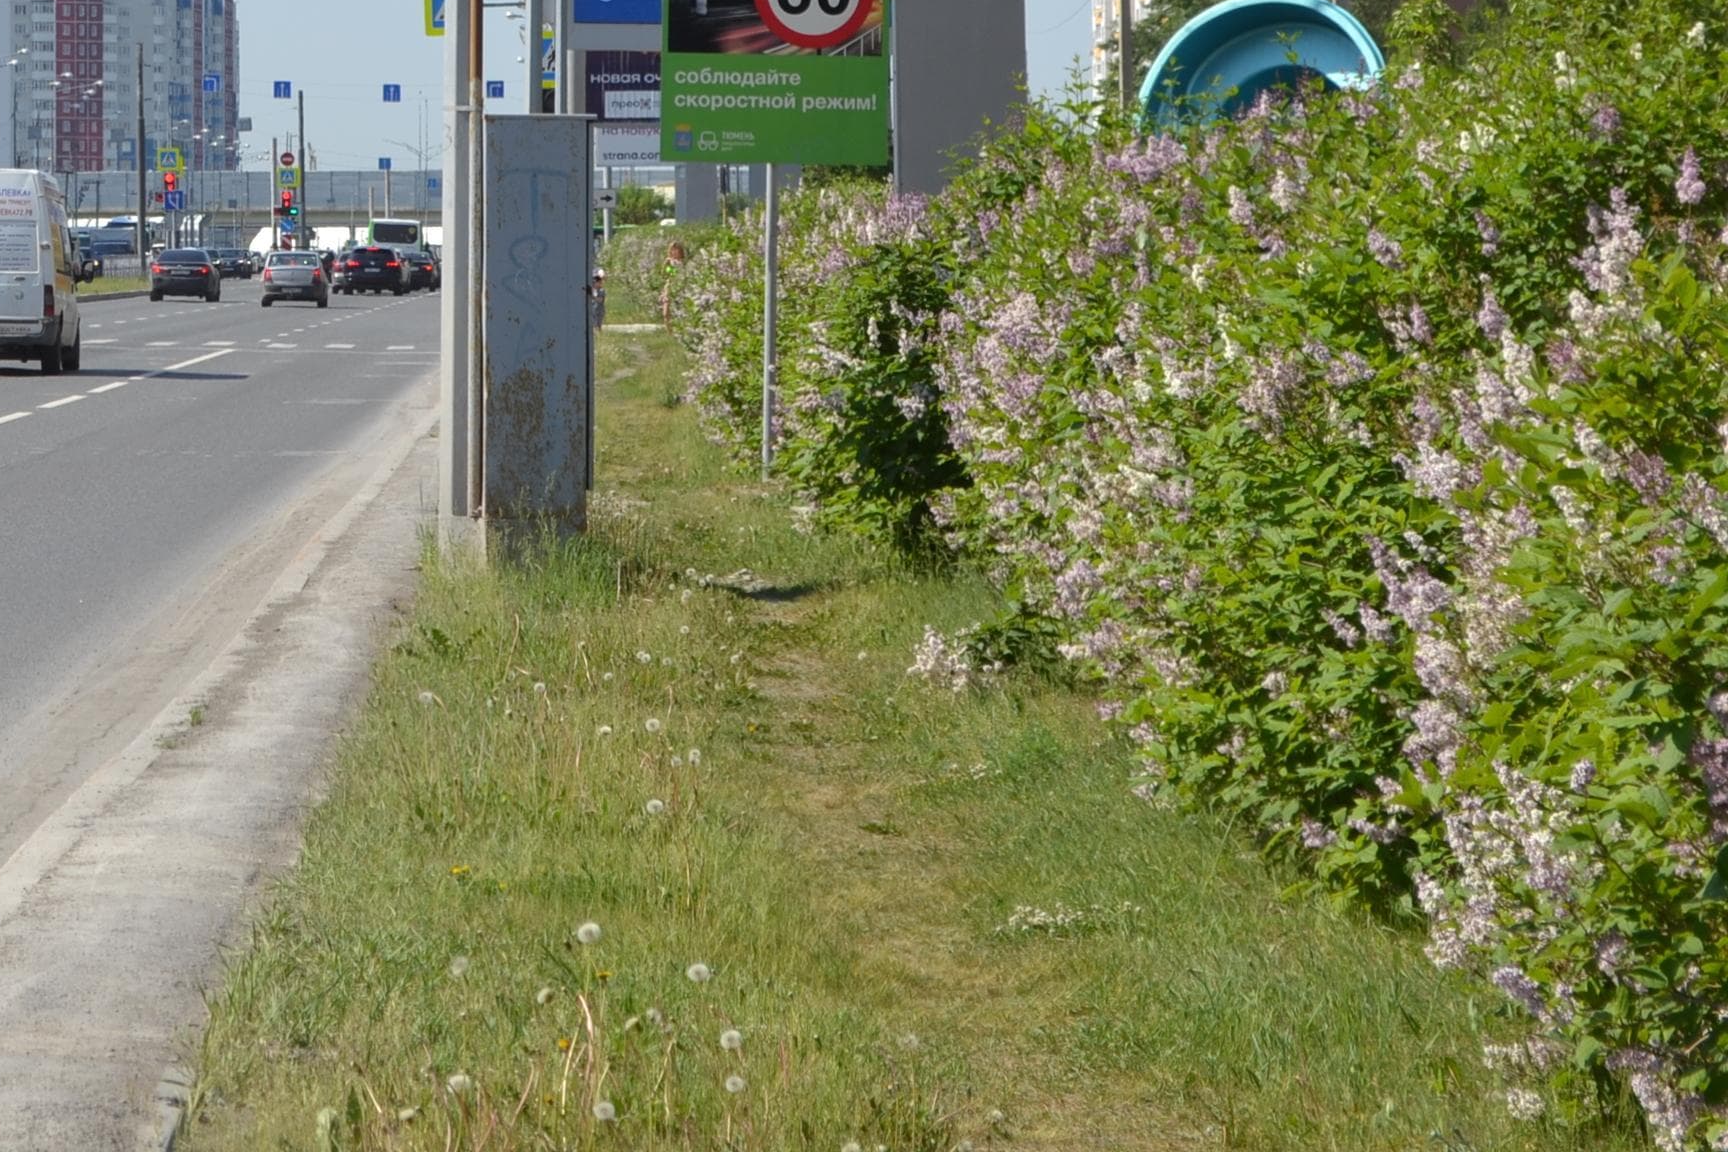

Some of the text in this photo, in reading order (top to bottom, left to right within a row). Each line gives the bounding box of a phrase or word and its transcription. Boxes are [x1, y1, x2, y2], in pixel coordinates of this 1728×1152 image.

[590, 73, 641, 84] новая
[674, 67, 801, 88] соблюдайте
[674, 91, 877, 113] скоростной режим!
